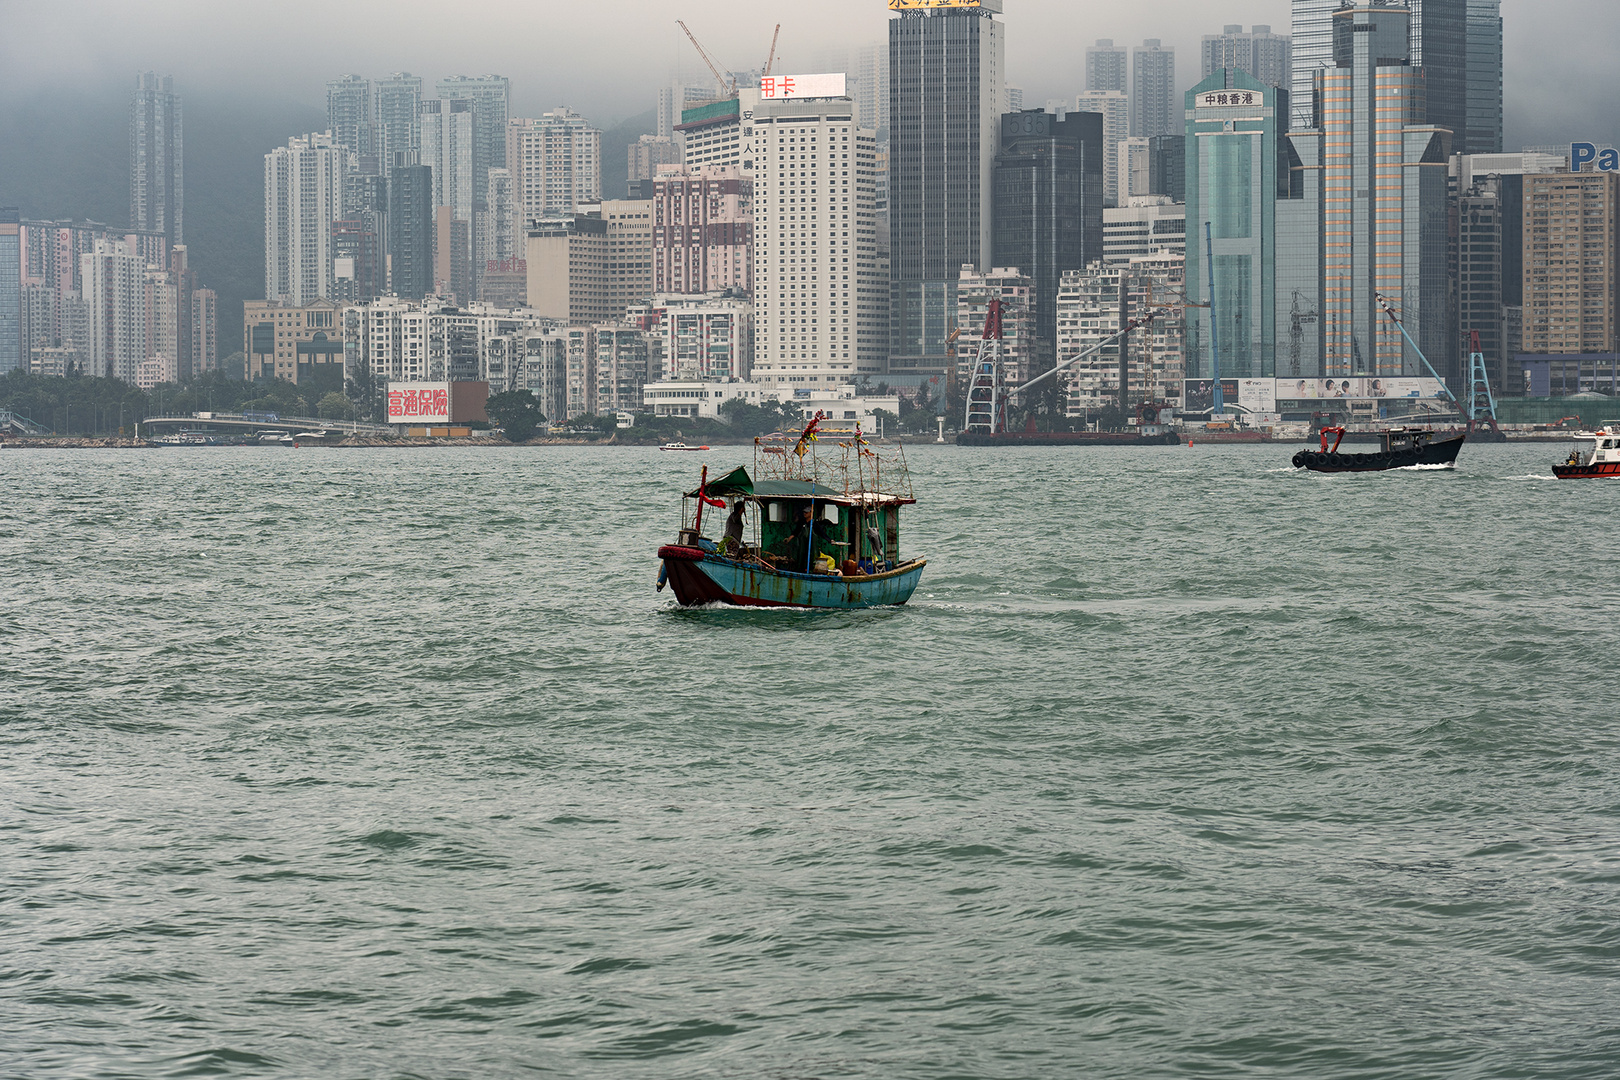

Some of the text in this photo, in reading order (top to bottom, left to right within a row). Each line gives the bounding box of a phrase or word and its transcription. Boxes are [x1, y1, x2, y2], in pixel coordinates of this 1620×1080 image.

[1205, 93, 1253, 106] 中粮香港
[1009, 114, 1045, 134] 535
[1570, 141, 1620, 172] Pa
[388, 389, 448, 416] 富通保險
